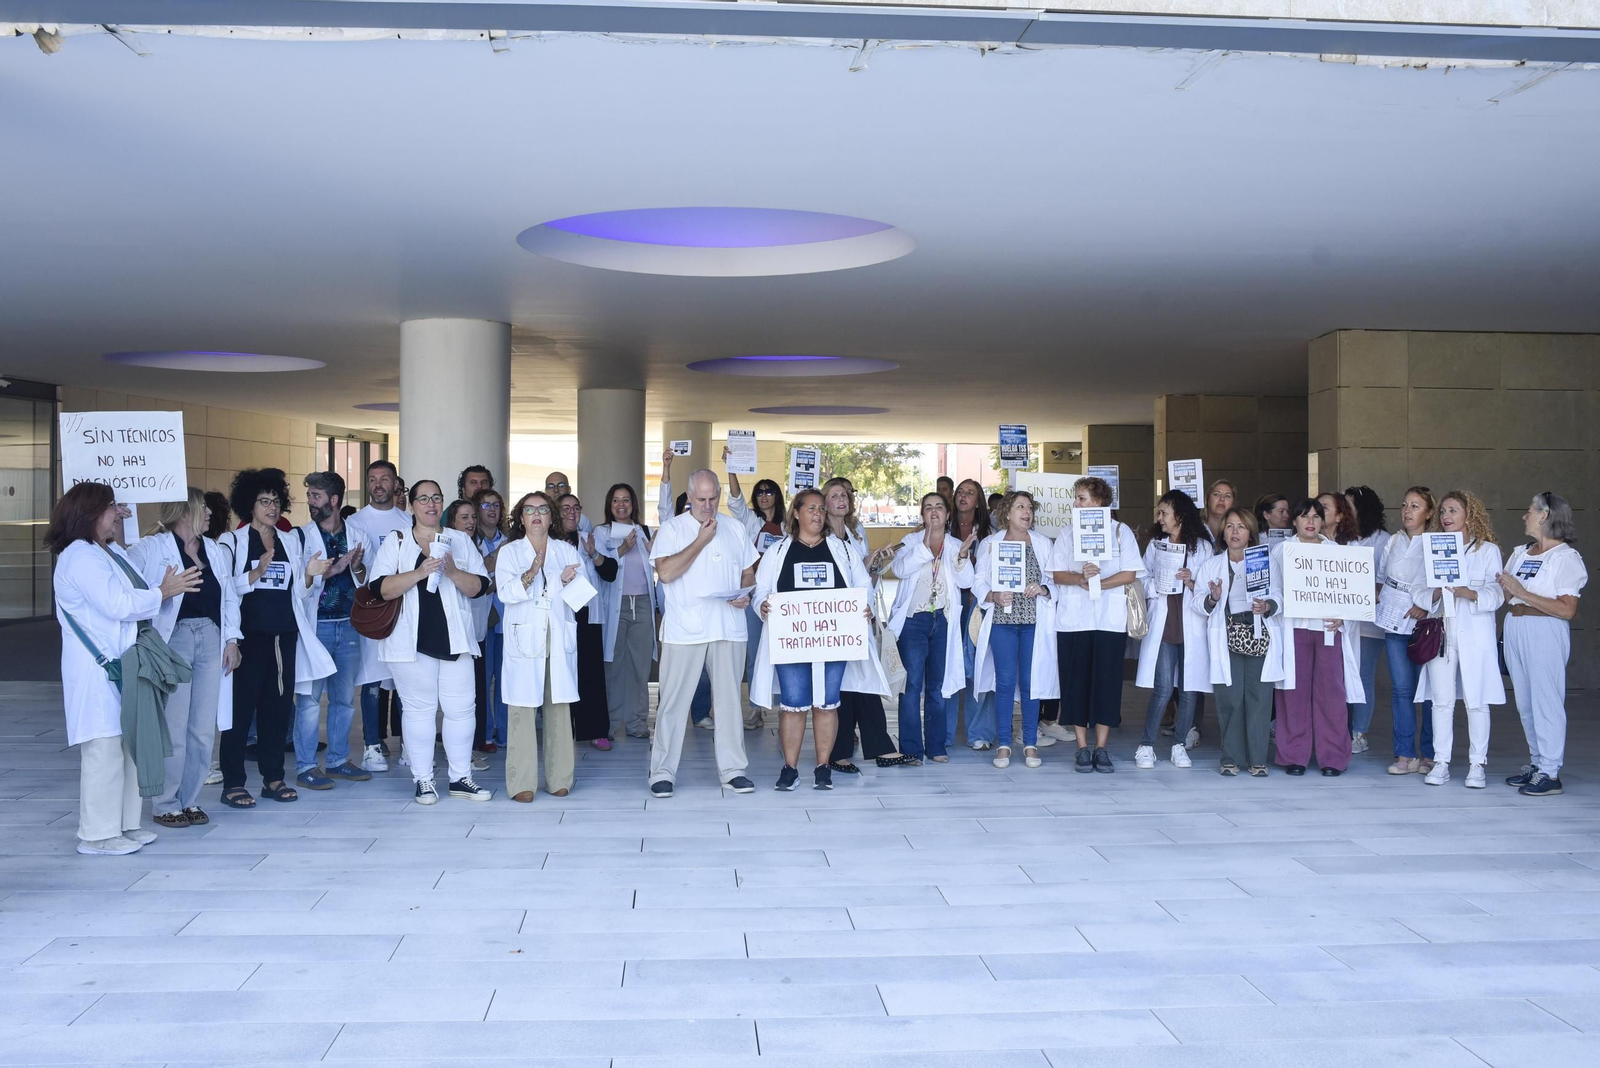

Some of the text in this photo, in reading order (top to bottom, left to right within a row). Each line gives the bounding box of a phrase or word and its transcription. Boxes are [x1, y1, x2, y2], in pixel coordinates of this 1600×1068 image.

[82, 427, 176, 444] SIN TÉCNICOS
[1002, 444, 1018, 452] HUELGA
[97, 455, 146, 467] NO HAY
[1027, 484, 1044, 497] SIN
[1039, 502, 1052, 514] NO
[1058, 503, 1072, 514] HA
[1294, 556, 1313, 570] SIN
[1305, 576, 1347, 589] NO HAY
[1292, 590, 1371, 606] TRATAMIENTOS
[780, 600, 801, 616] SIN
[792, 619, 837, 632] NO HAY
[778, 634, 863, 649] TRATAMIENTOS
